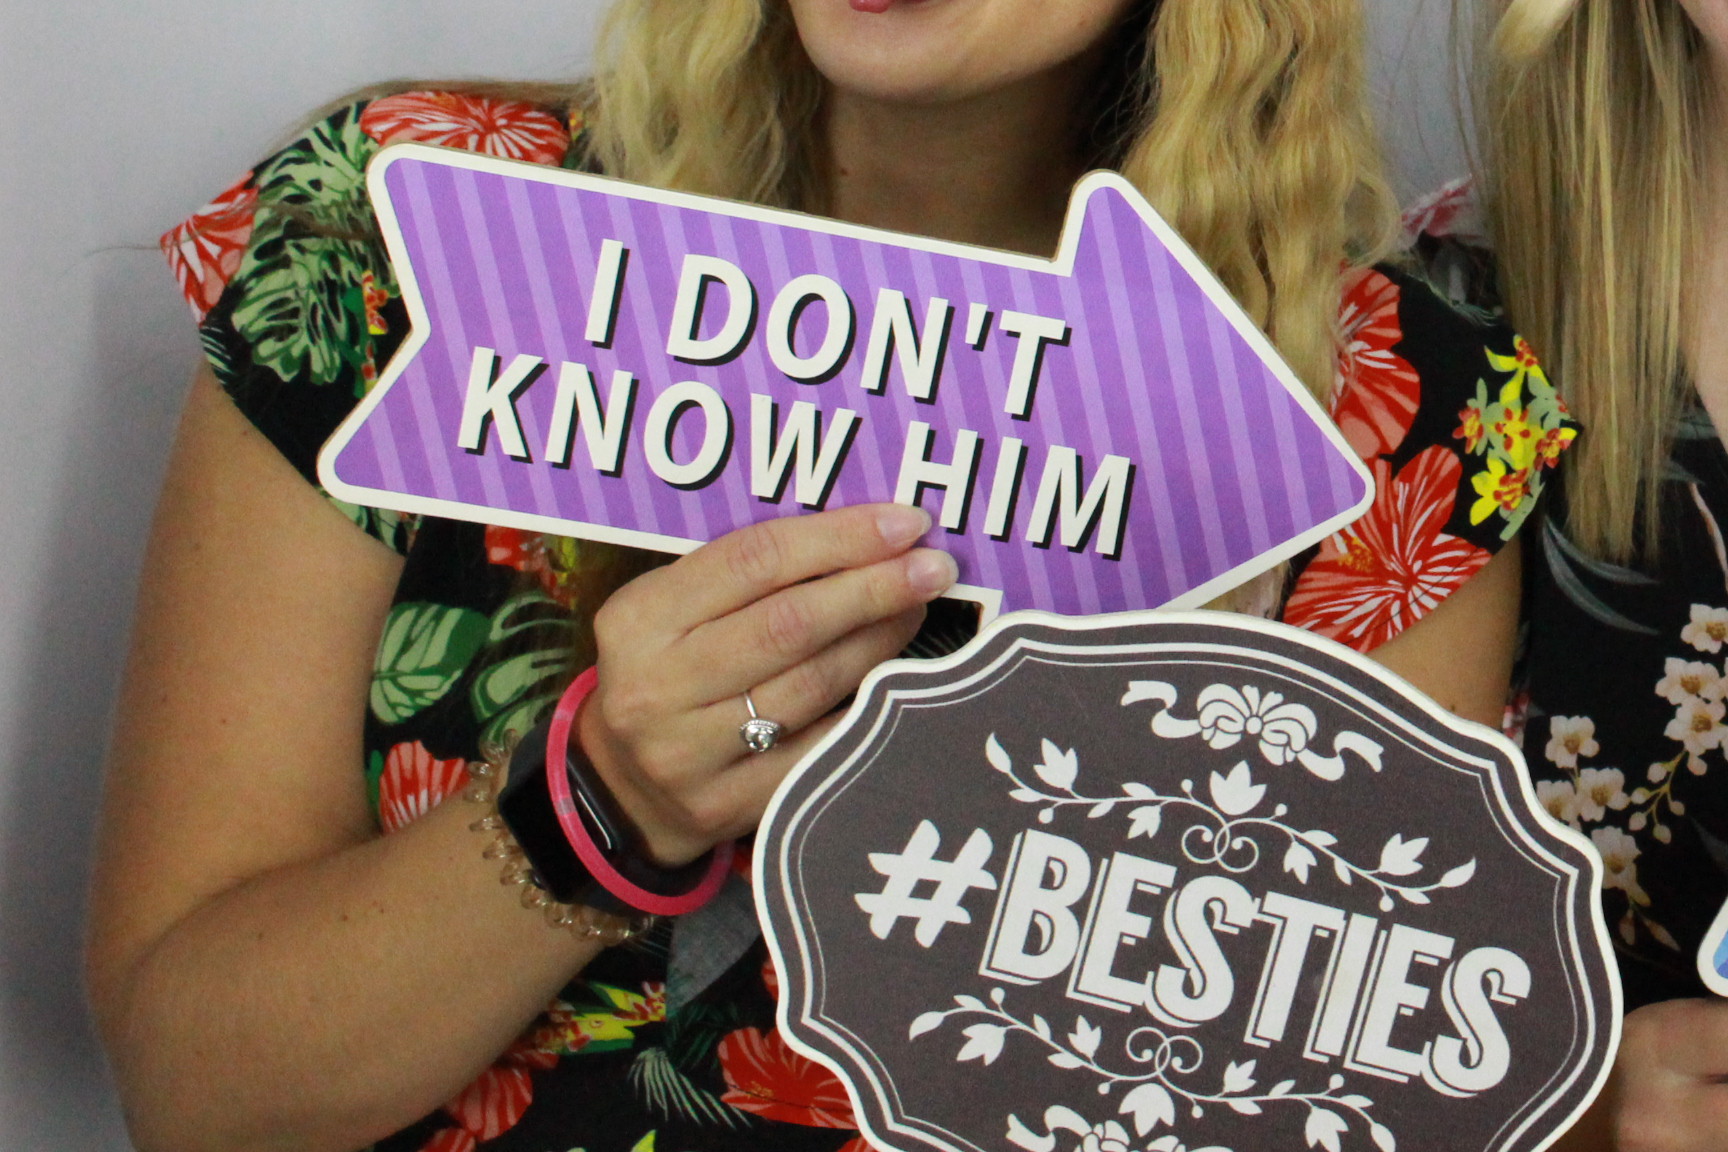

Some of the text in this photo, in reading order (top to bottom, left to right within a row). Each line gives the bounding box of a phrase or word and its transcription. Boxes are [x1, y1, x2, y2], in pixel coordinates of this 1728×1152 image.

[583, 237, 1070, 421] I DON'T
[456, 344, 1135, 560] KNOW HIM
[854, 818, 1533, 1098] #BESTIES
